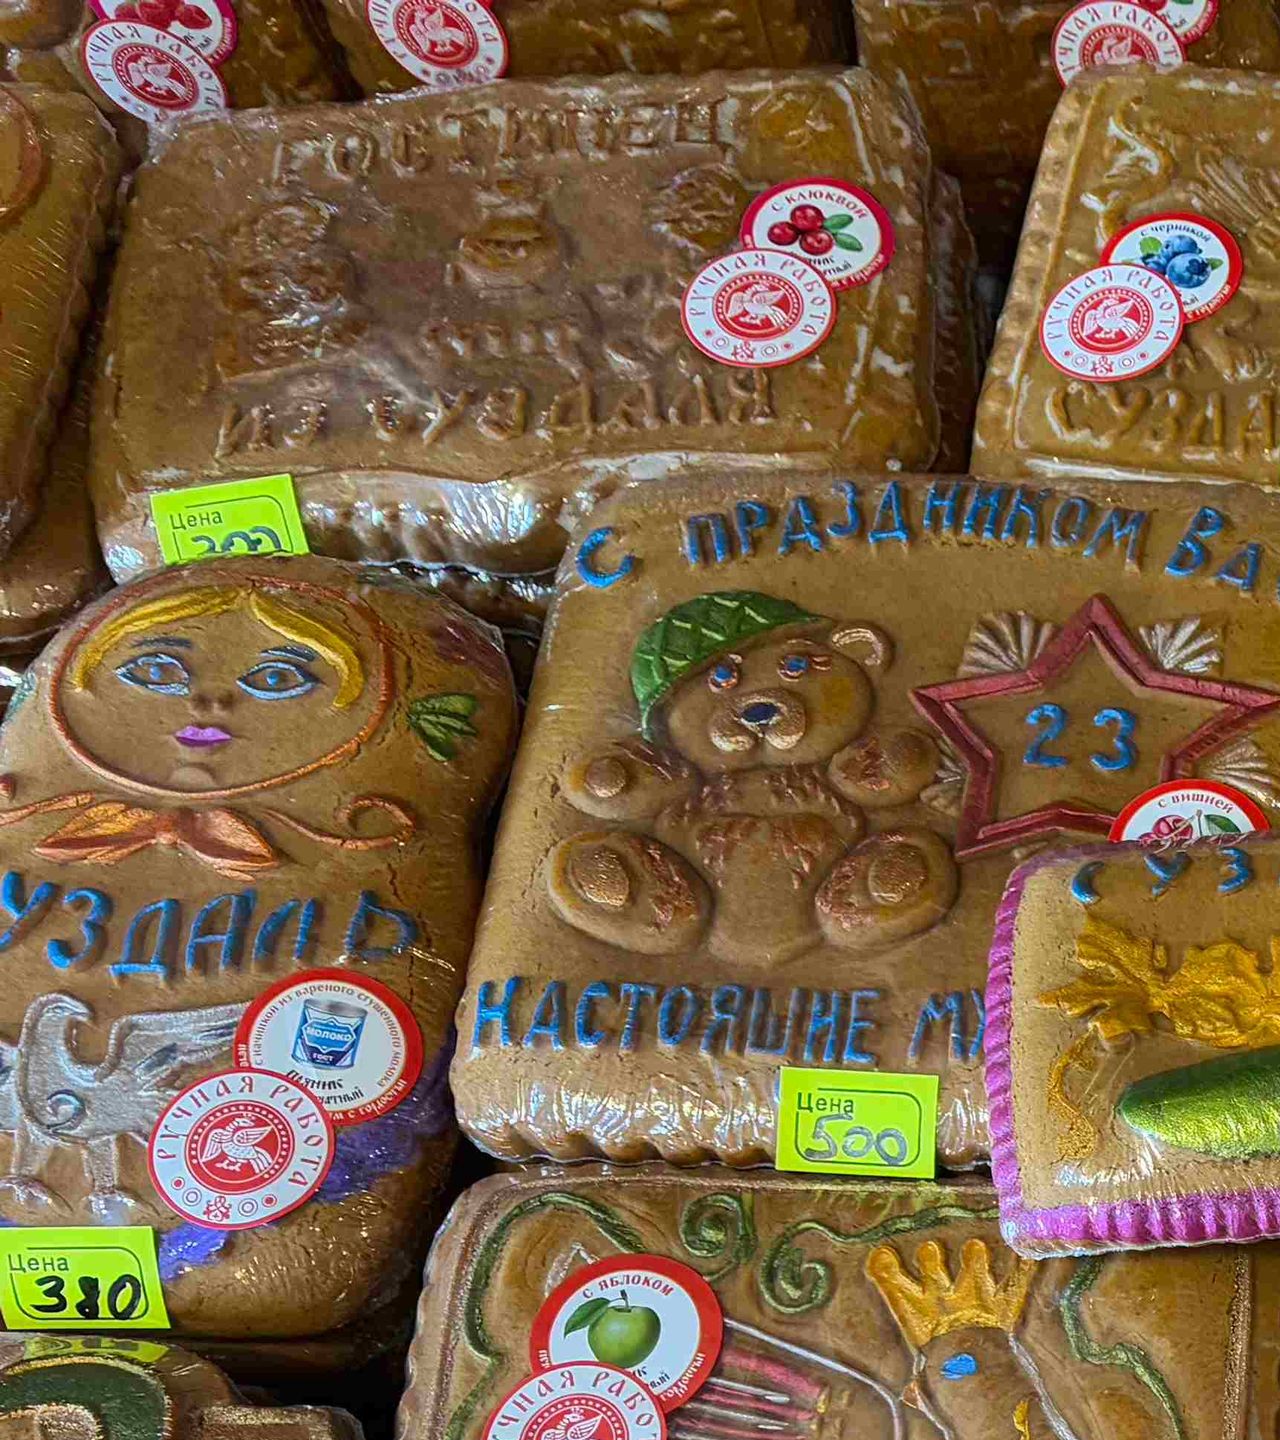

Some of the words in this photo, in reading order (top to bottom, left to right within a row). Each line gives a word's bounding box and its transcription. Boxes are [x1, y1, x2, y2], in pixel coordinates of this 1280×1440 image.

[1059, 4, 1098, 73] УЧНАЯ
[170, 509, 224, 532] Цена
[1023, 702, 1139, 771] 23
[0, 870, 418, 982] УЗДАЛЬ
[797, 1091, 855, 1115] Цена
[157, 1076, 254, 1160] РУЧНАЯ
[270, 1085, 324, 1188] РАБОТА
[804, 1113, 908, 1165] 500
[9, 1253, 70, 1275] Цена
[31, 1275, 142, 1321] 380
